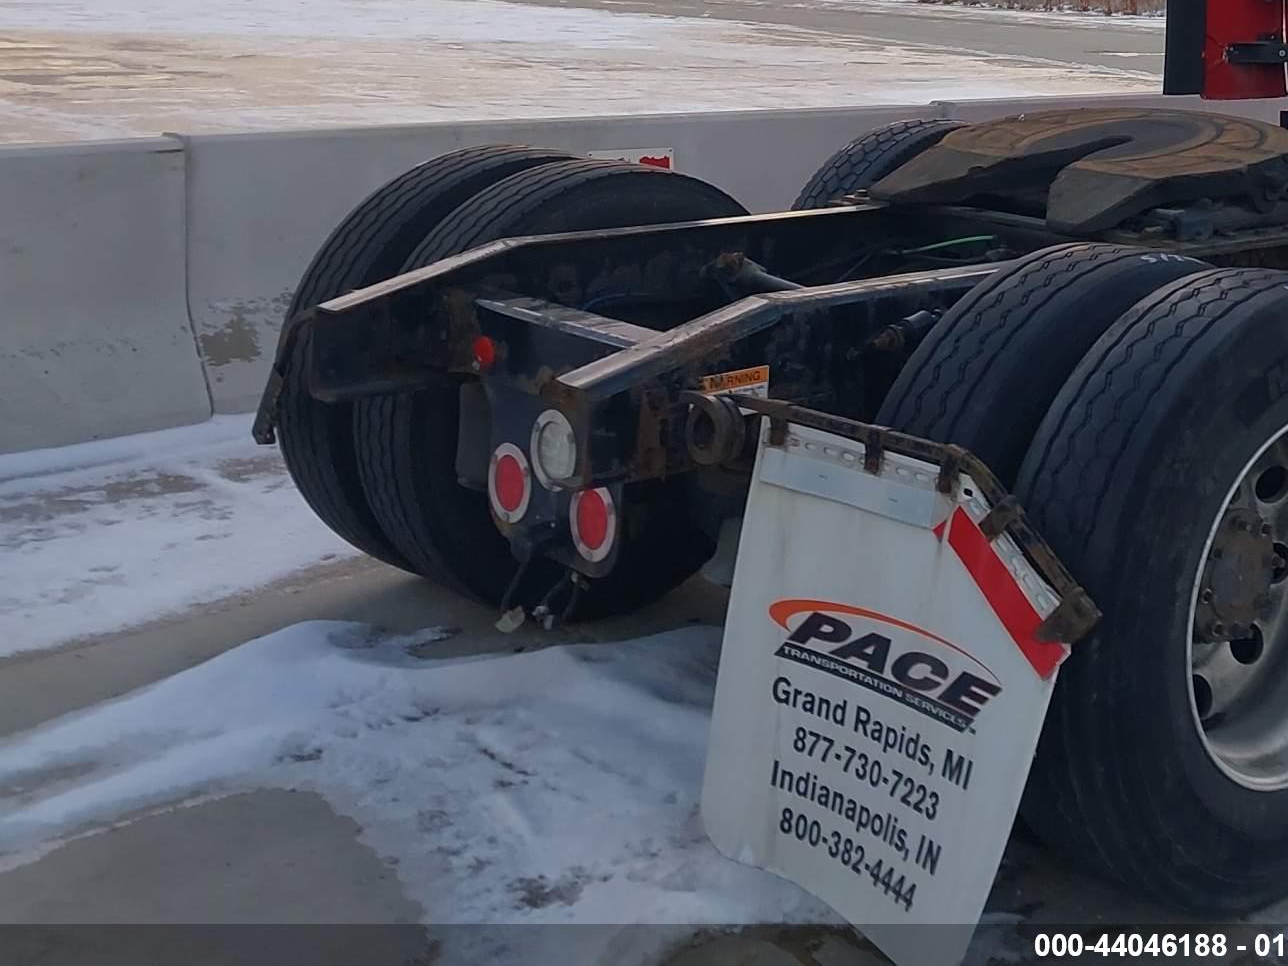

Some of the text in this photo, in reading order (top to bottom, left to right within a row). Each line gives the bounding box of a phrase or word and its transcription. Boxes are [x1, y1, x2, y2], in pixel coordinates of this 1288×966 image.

[783, 644, 968, 728] TRANSPORTATION SERVICES
[787, 611, 1003, 717] PACE
[772, 676, 974, 791] Grand Rapids, MI
[792, 726, 940, 821] 877-730-7223
[770, 759, 942, 877] Indianapolis, IN
[779, 807, 917, 913] 800-382-4444
